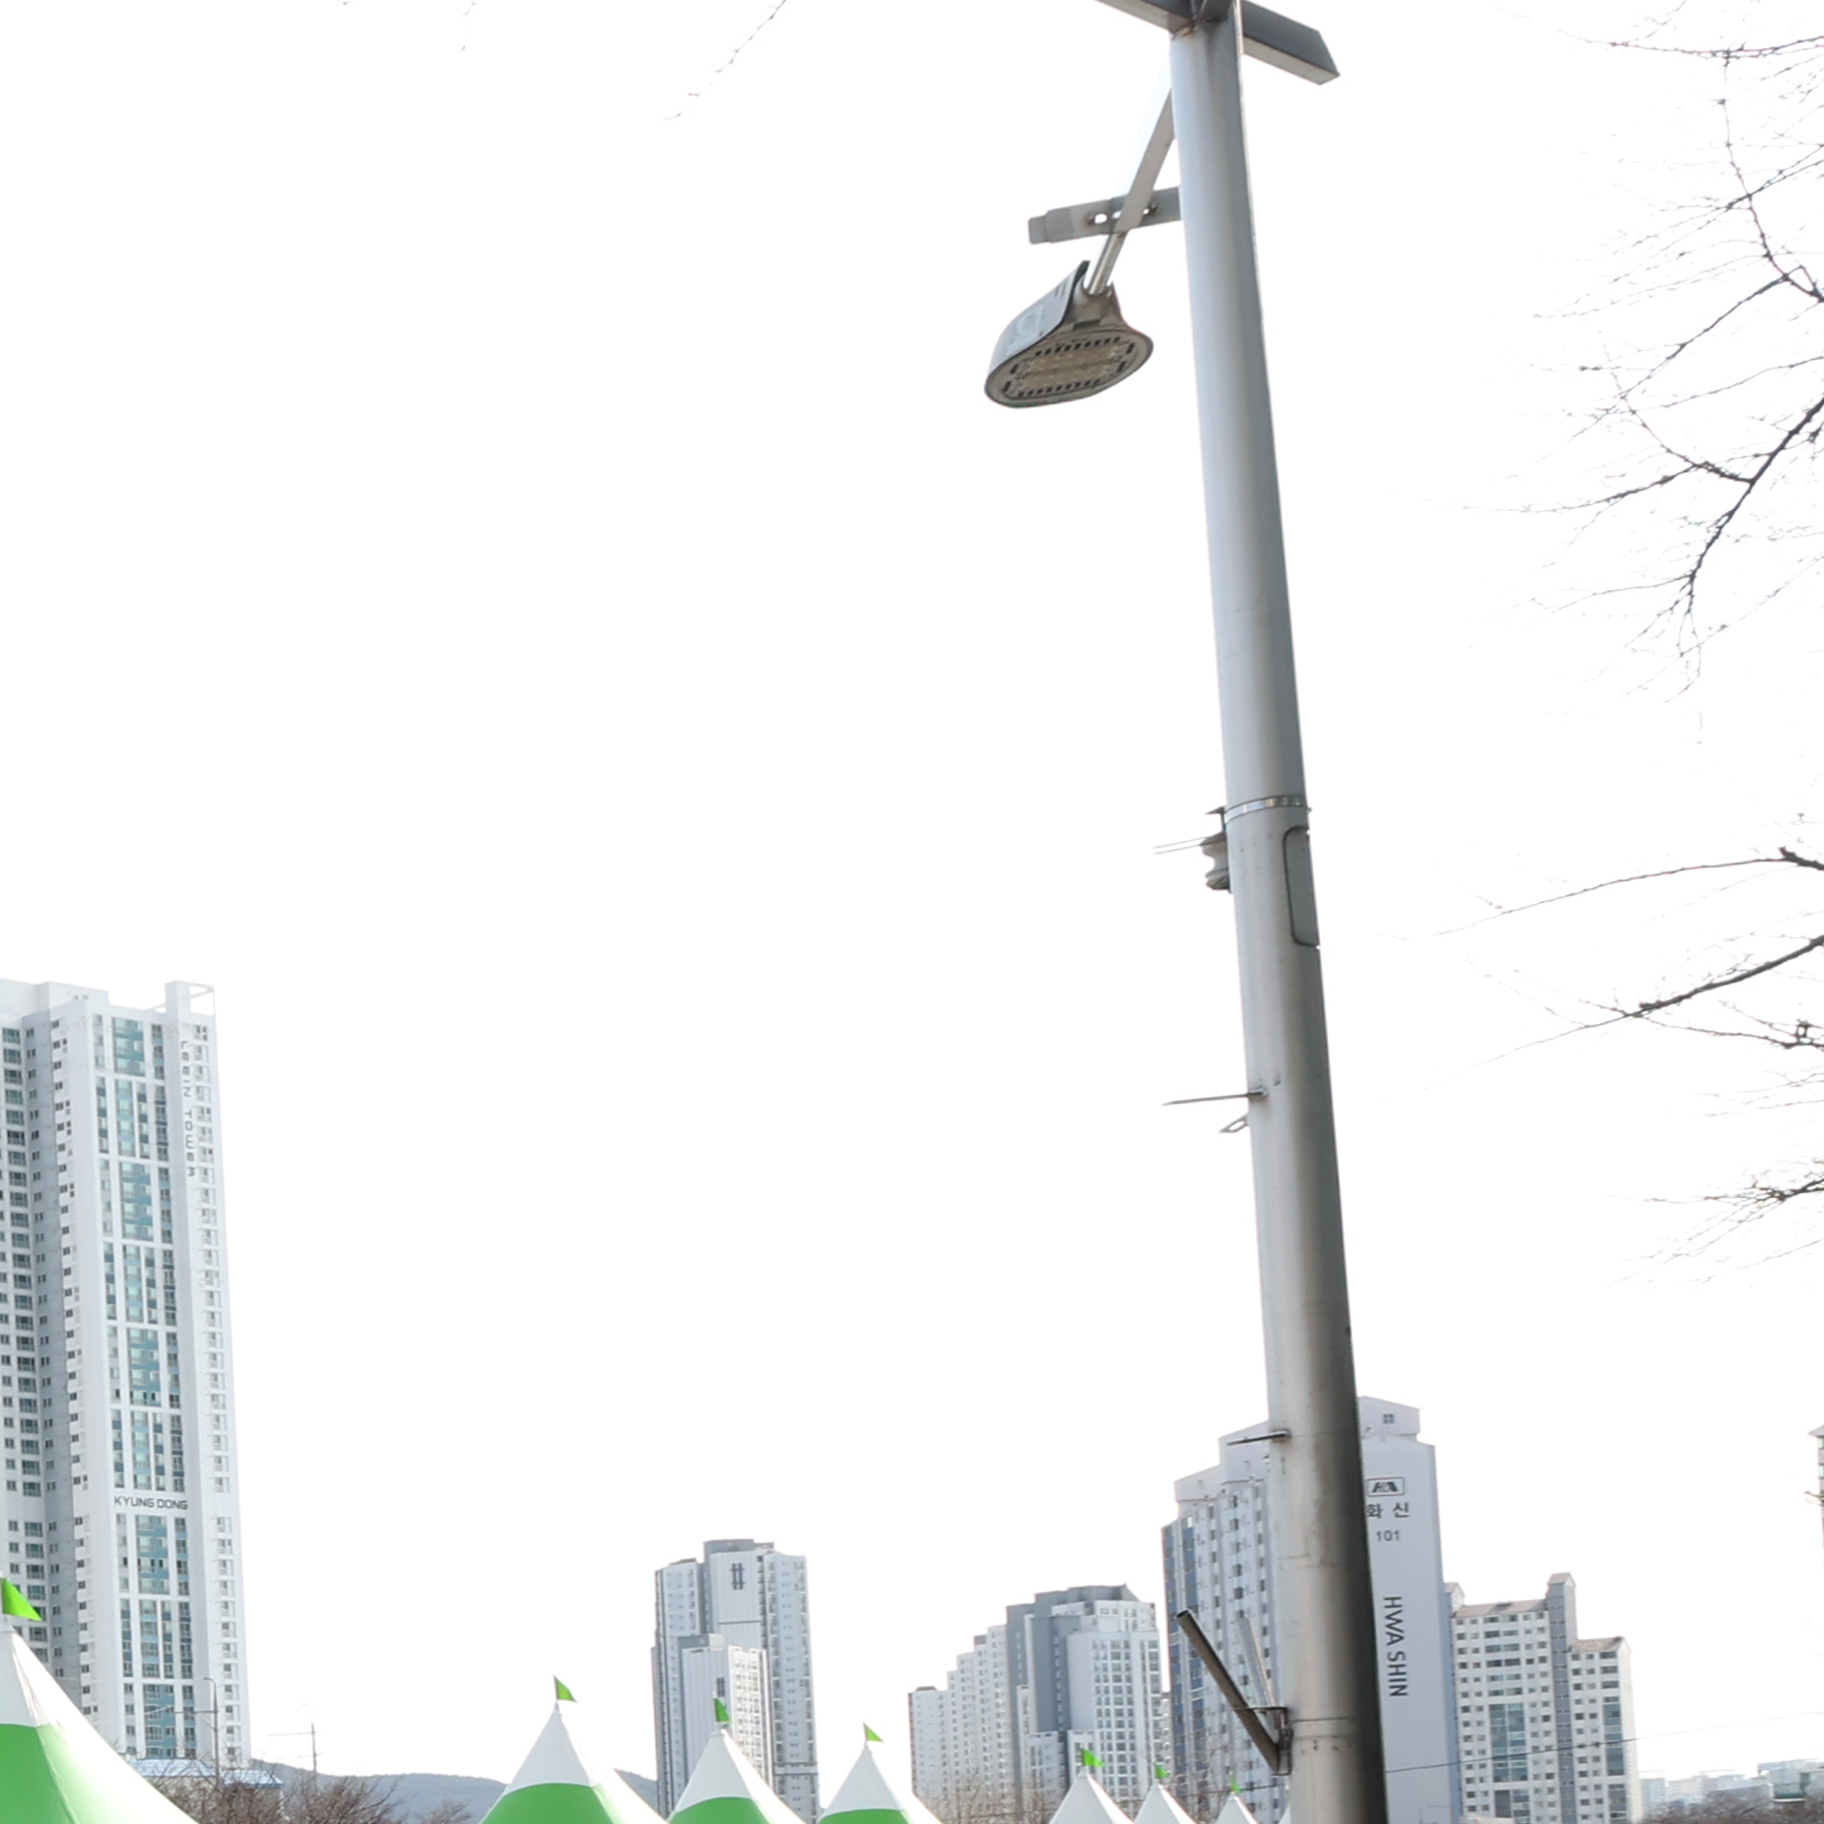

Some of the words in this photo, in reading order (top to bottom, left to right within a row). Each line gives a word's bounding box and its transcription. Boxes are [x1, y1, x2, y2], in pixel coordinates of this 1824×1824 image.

[114, 1496, 154, 1508] KYUNG
[157, 1499, 188, 1510] DONG
[1375, 1530, 1401, 1542] 101
